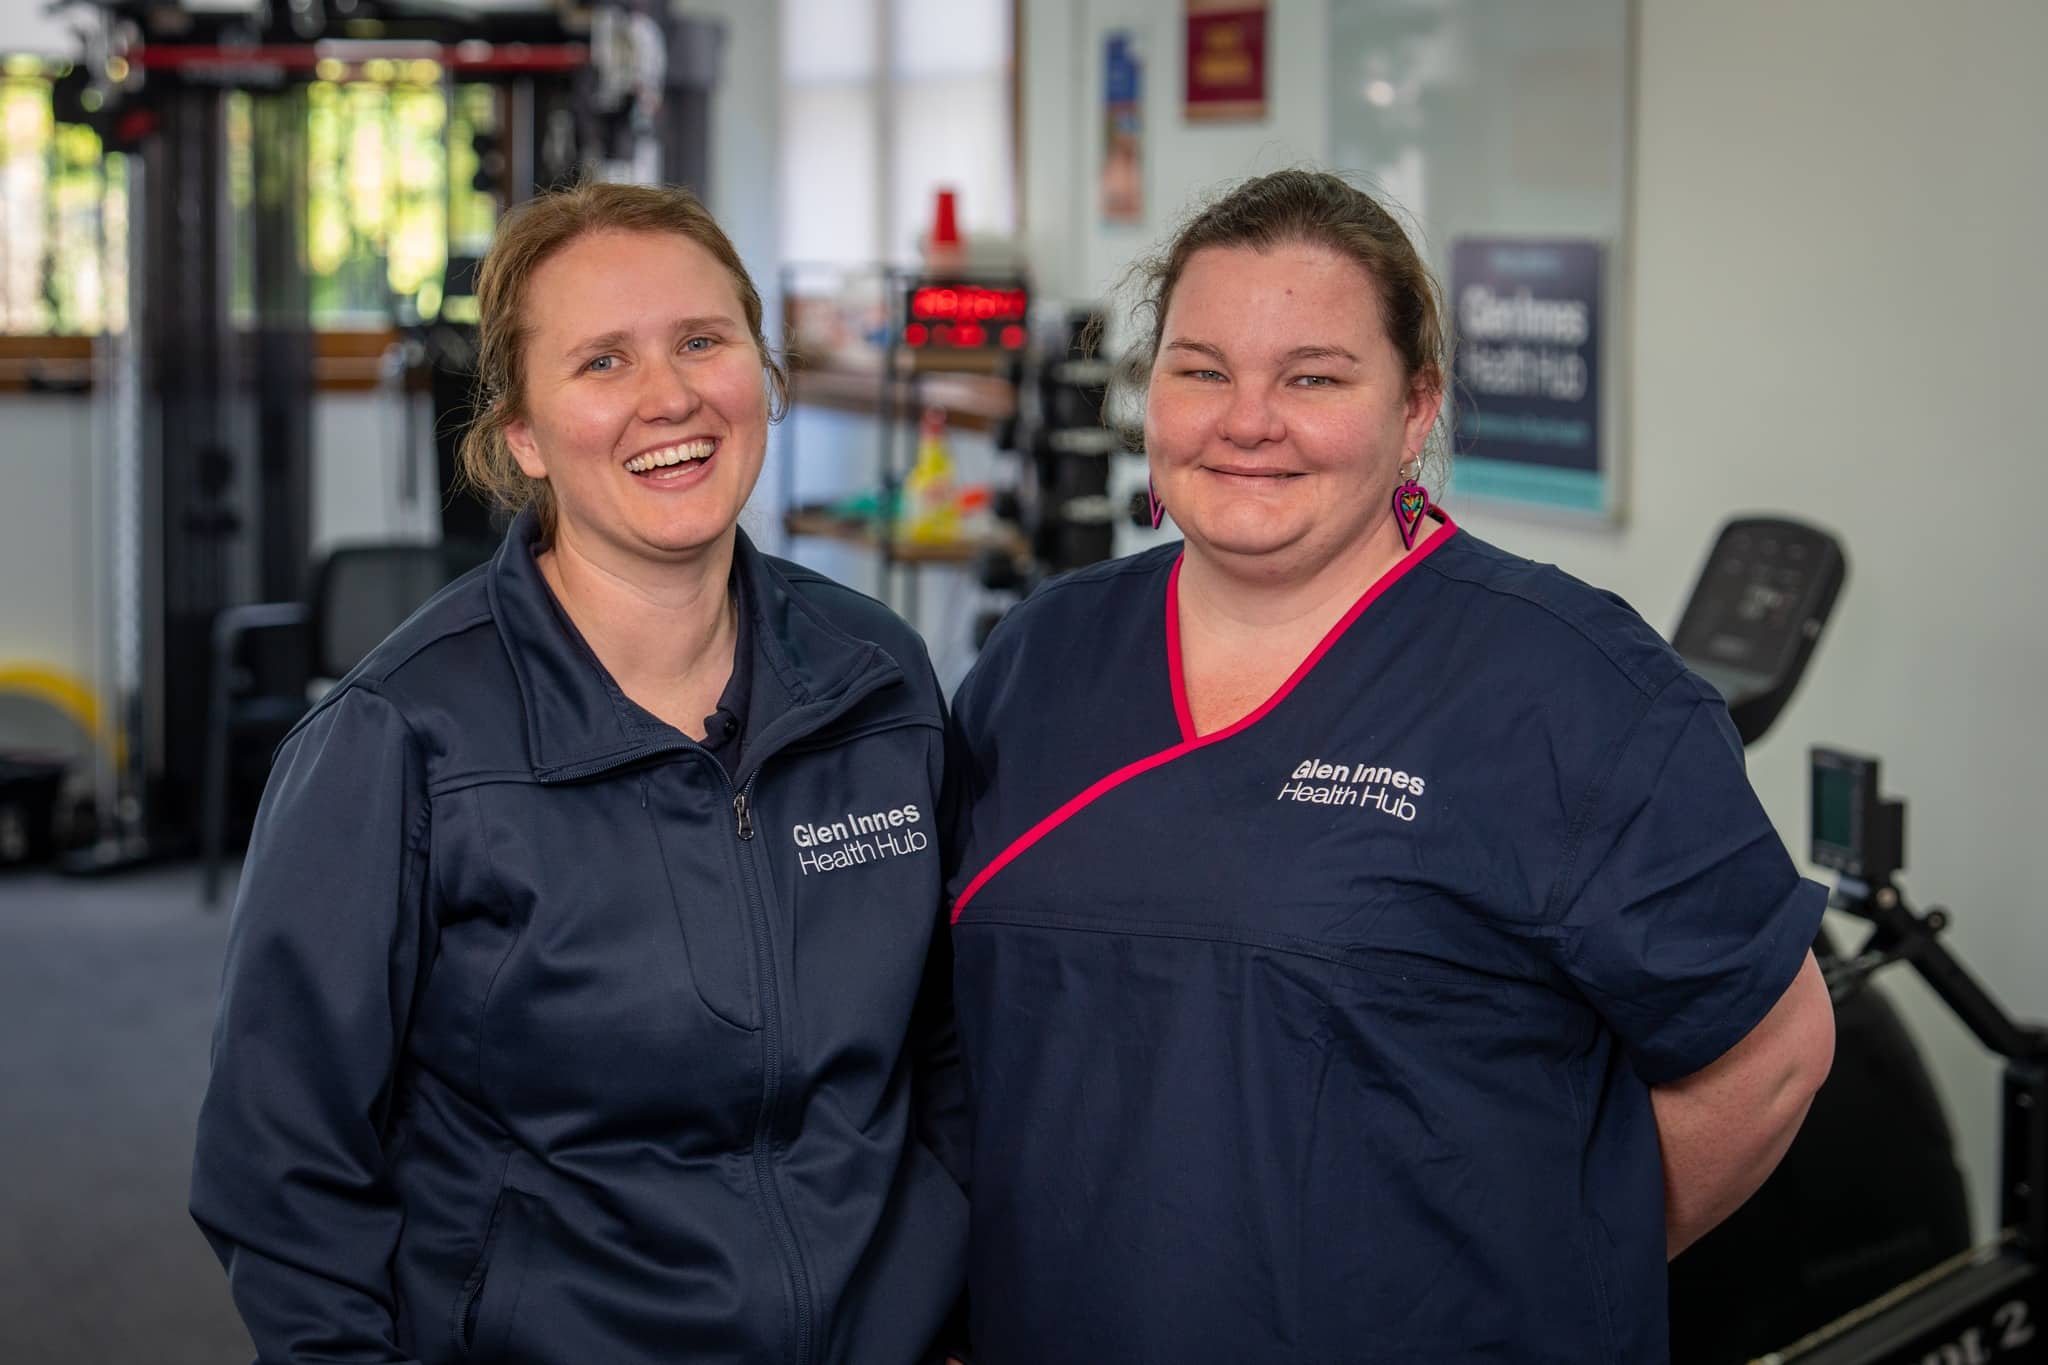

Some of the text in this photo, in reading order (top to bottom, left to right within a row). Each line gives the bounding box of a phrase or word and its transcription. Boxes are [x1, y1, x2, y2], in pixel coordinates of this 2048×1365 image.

[1291, 758, 1425, 796] Glen Innes
[1277, 781, 1417, 821] Health Hub
[793, 804, 920, 847] Glen Innes
[798, 828, 927, 875] Health Hub
[1991, 1299, 2037, 1350] 2
